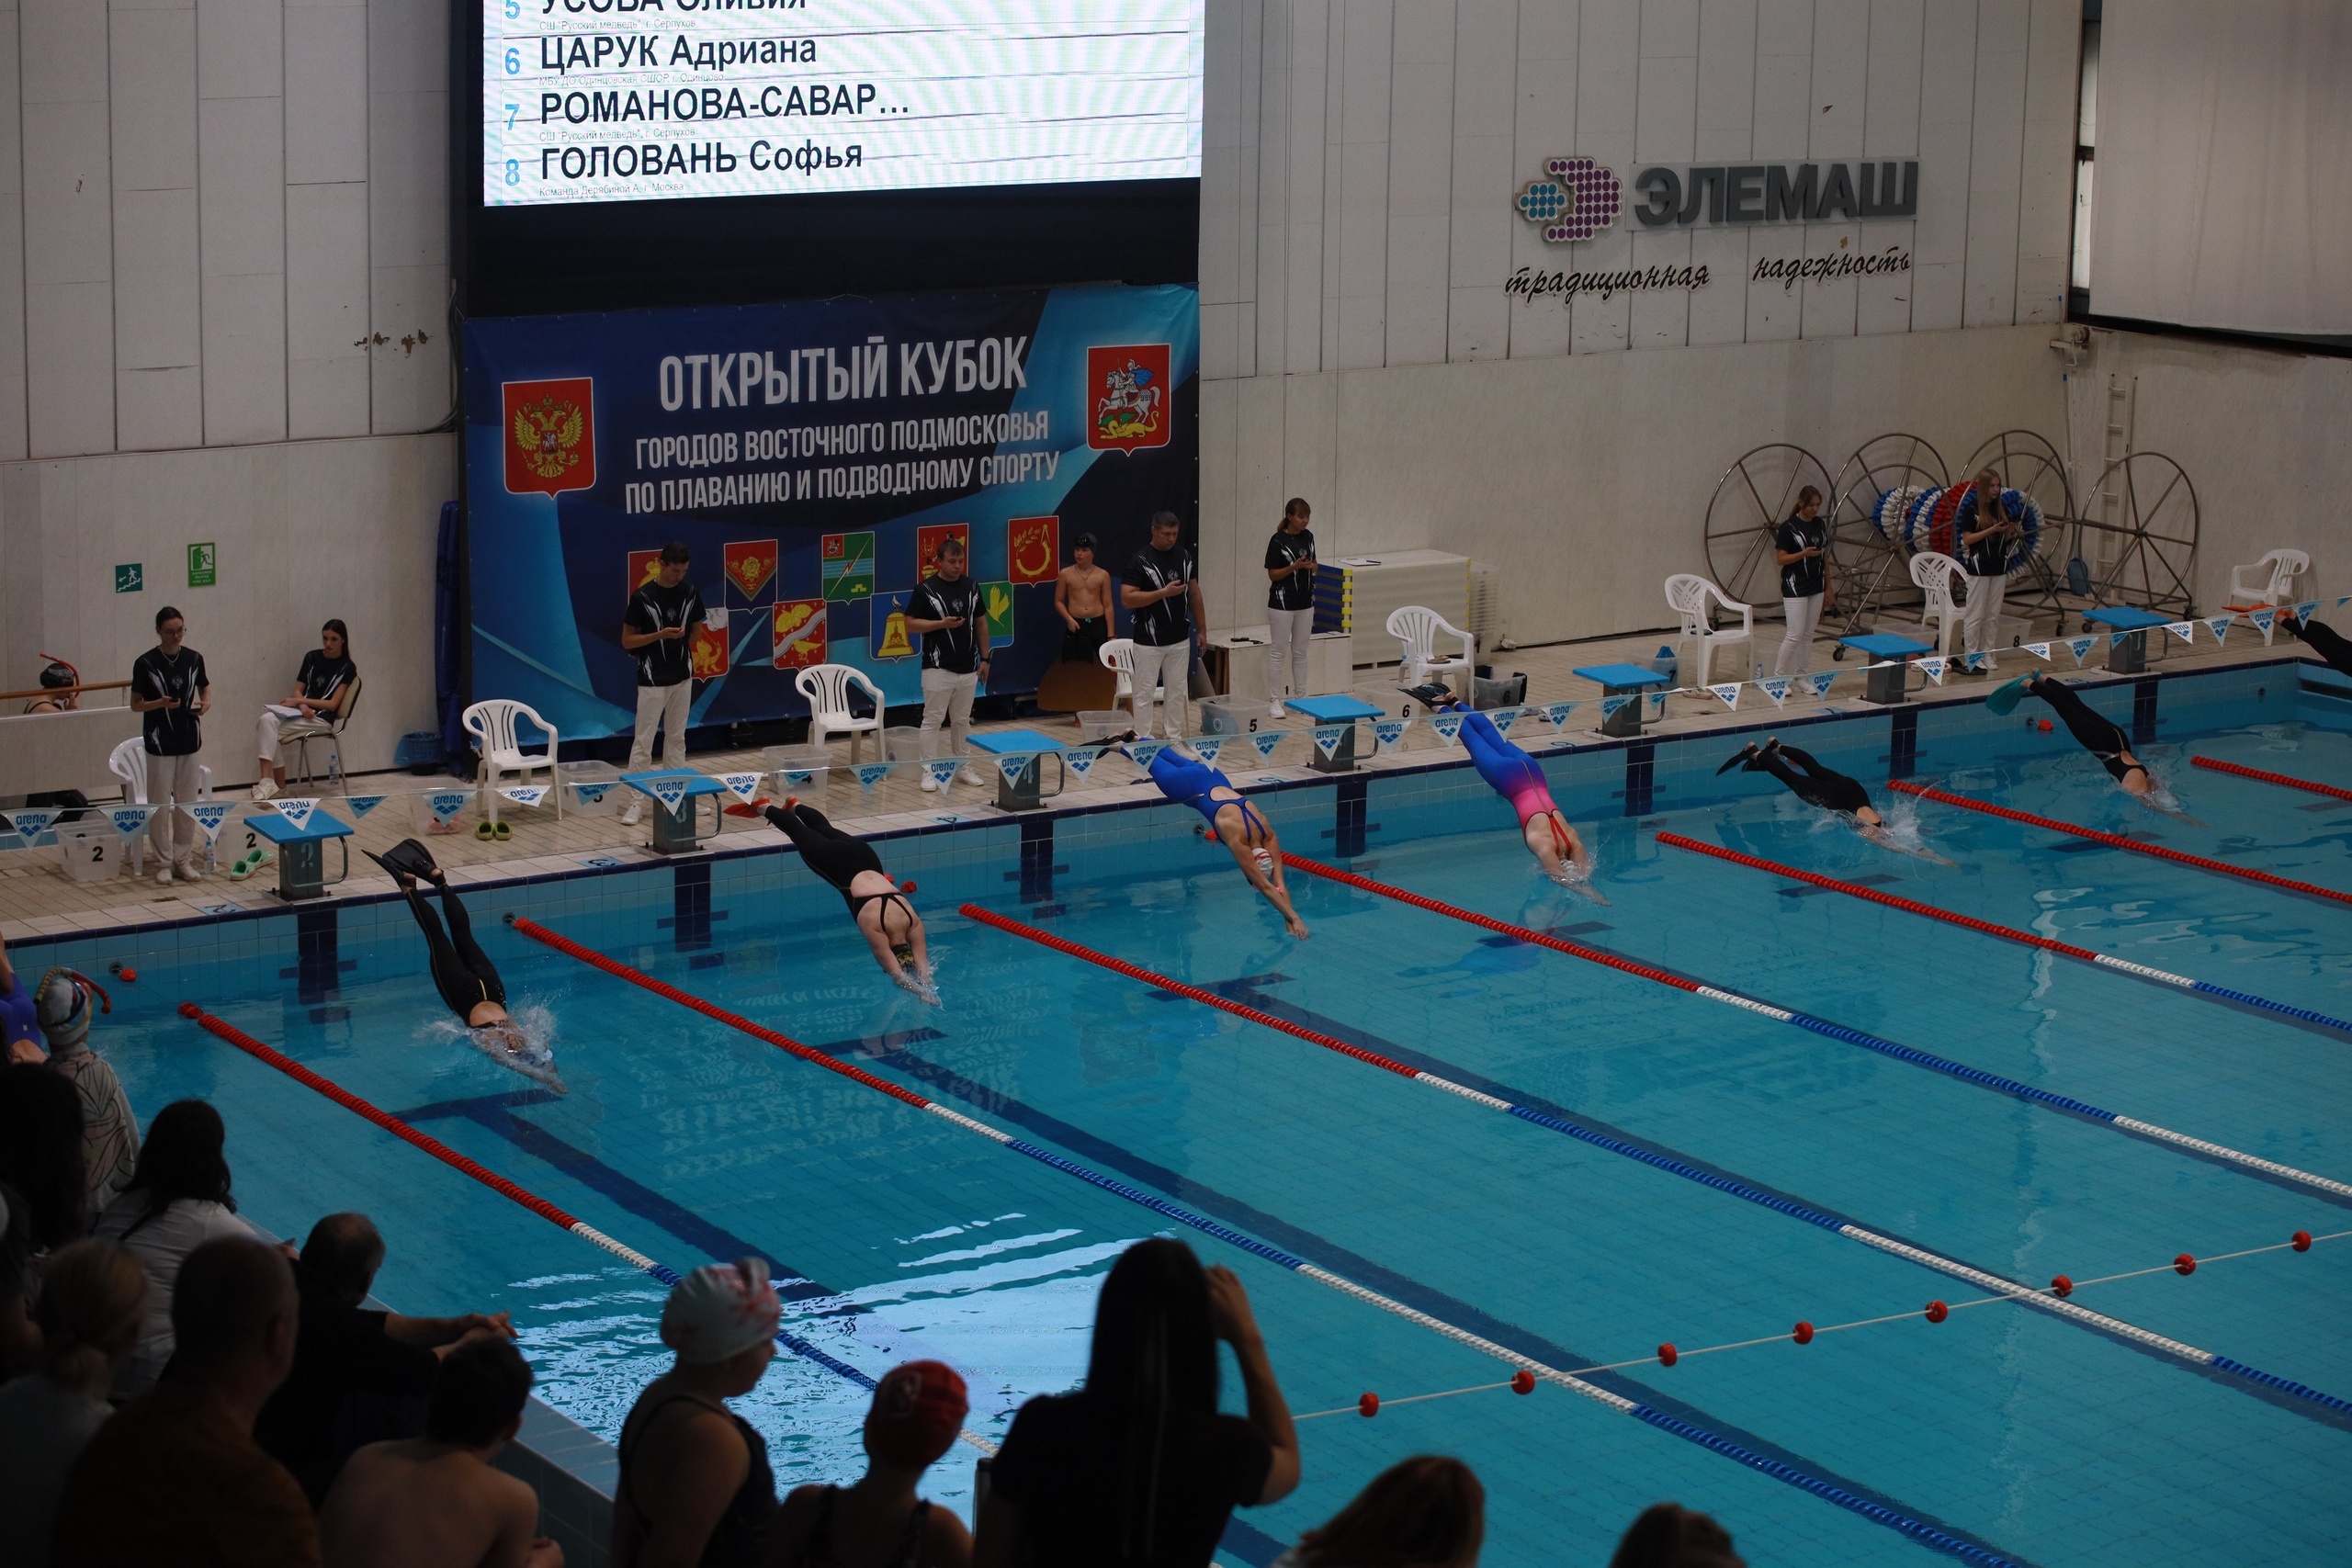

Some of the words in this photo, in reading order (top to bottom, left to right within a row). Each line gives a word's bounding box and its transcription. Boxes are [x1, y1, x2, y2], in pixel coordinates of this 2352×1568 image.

[654, 18, 696, 30] Серпухов
[505, 48, 520, 74] 6
[541, 35, 659, 75] ЦАРУК
[669, 35, 817, 72] Адриана
[579, 74, 638, 86] Одинцовская
[680, 73, 724, 84] Одинцово
[505, 104, 520, 130] 7
[541, 84, 909, 124] РОМАНОВА-САВАР...
[539, 131, 555, 141] СШ
[653, 128, 695, 140] Серпухов
[505, 158, 520, 186] 8
[542, 142, 738, 180] ГОЛОВАНЬ
[750, 139, 862, 176] Софья
[539, 186, 579, 197] Команда
[582, 184, 630, 197] Дерябиной
[651, 182, 684, 193] Москва
[1634, 162, 1918, 226] ЭЛЕМАШ
[1505, 265, 1710, 304] традиционная
[1753, 246, 1911, 290] надежность
[660, 335, 888, 412] ОТКРЫТЫЙ
[900, 335, 1027, 396] КУБОК
[636, 432, 738, 469] ГОРОДОВ
[745, 422, 885, 461] ВОСТОЧНОГО
[891, 411, 1048, 452] ПОДМОСКОВЬЯ
[626, 481, 655, 514] ПО
[662, 471, 790, 511] ПЛАВАНИЮ
[797, 469, 810, 500] И
[819, 457, 974, 499] ПОДВОДНОМУ
[979, 451, 1059, 486] СПОРТУ
[2013, 636, 2020, 648] 8
[1766, 681, 1785, 691] arena
[1503, 690, 1512, 705] 6
[1402, 705, 1411, 718] 6
[1494, 711, 1515, 722] arena
[1550, 705, 1569, 716] arena
[1250, 718, 1258, 733] 5
[1376, 723, 1402, 734] arena
[1435, 717, 1458, 728] arena
[1256, 735, 1279, 745] arena
[1316, 729, 1340, 739] arena
[1134, 745, 1158, 756] arena
[1195, 740, 1219, 750] arena
[1068, 750, 1093, 761] arena
[931, 761, 956, 773] arena
[1001, 756, 1026, 768] arena
[860, 766, 887, 777] arena
[727, 774, 755, 785] arena
[656, 781, 684, 793] arena
[434, 794, 464, 805] arena
[114, 809, 145, 821] arena
[194, 806, 223, 817] arena
[676, 798, 687, 825] 3
[16, 814, 47, 826] arena
[246, 832, 256, 849] 2
[92, 846, 104, 862] 2
